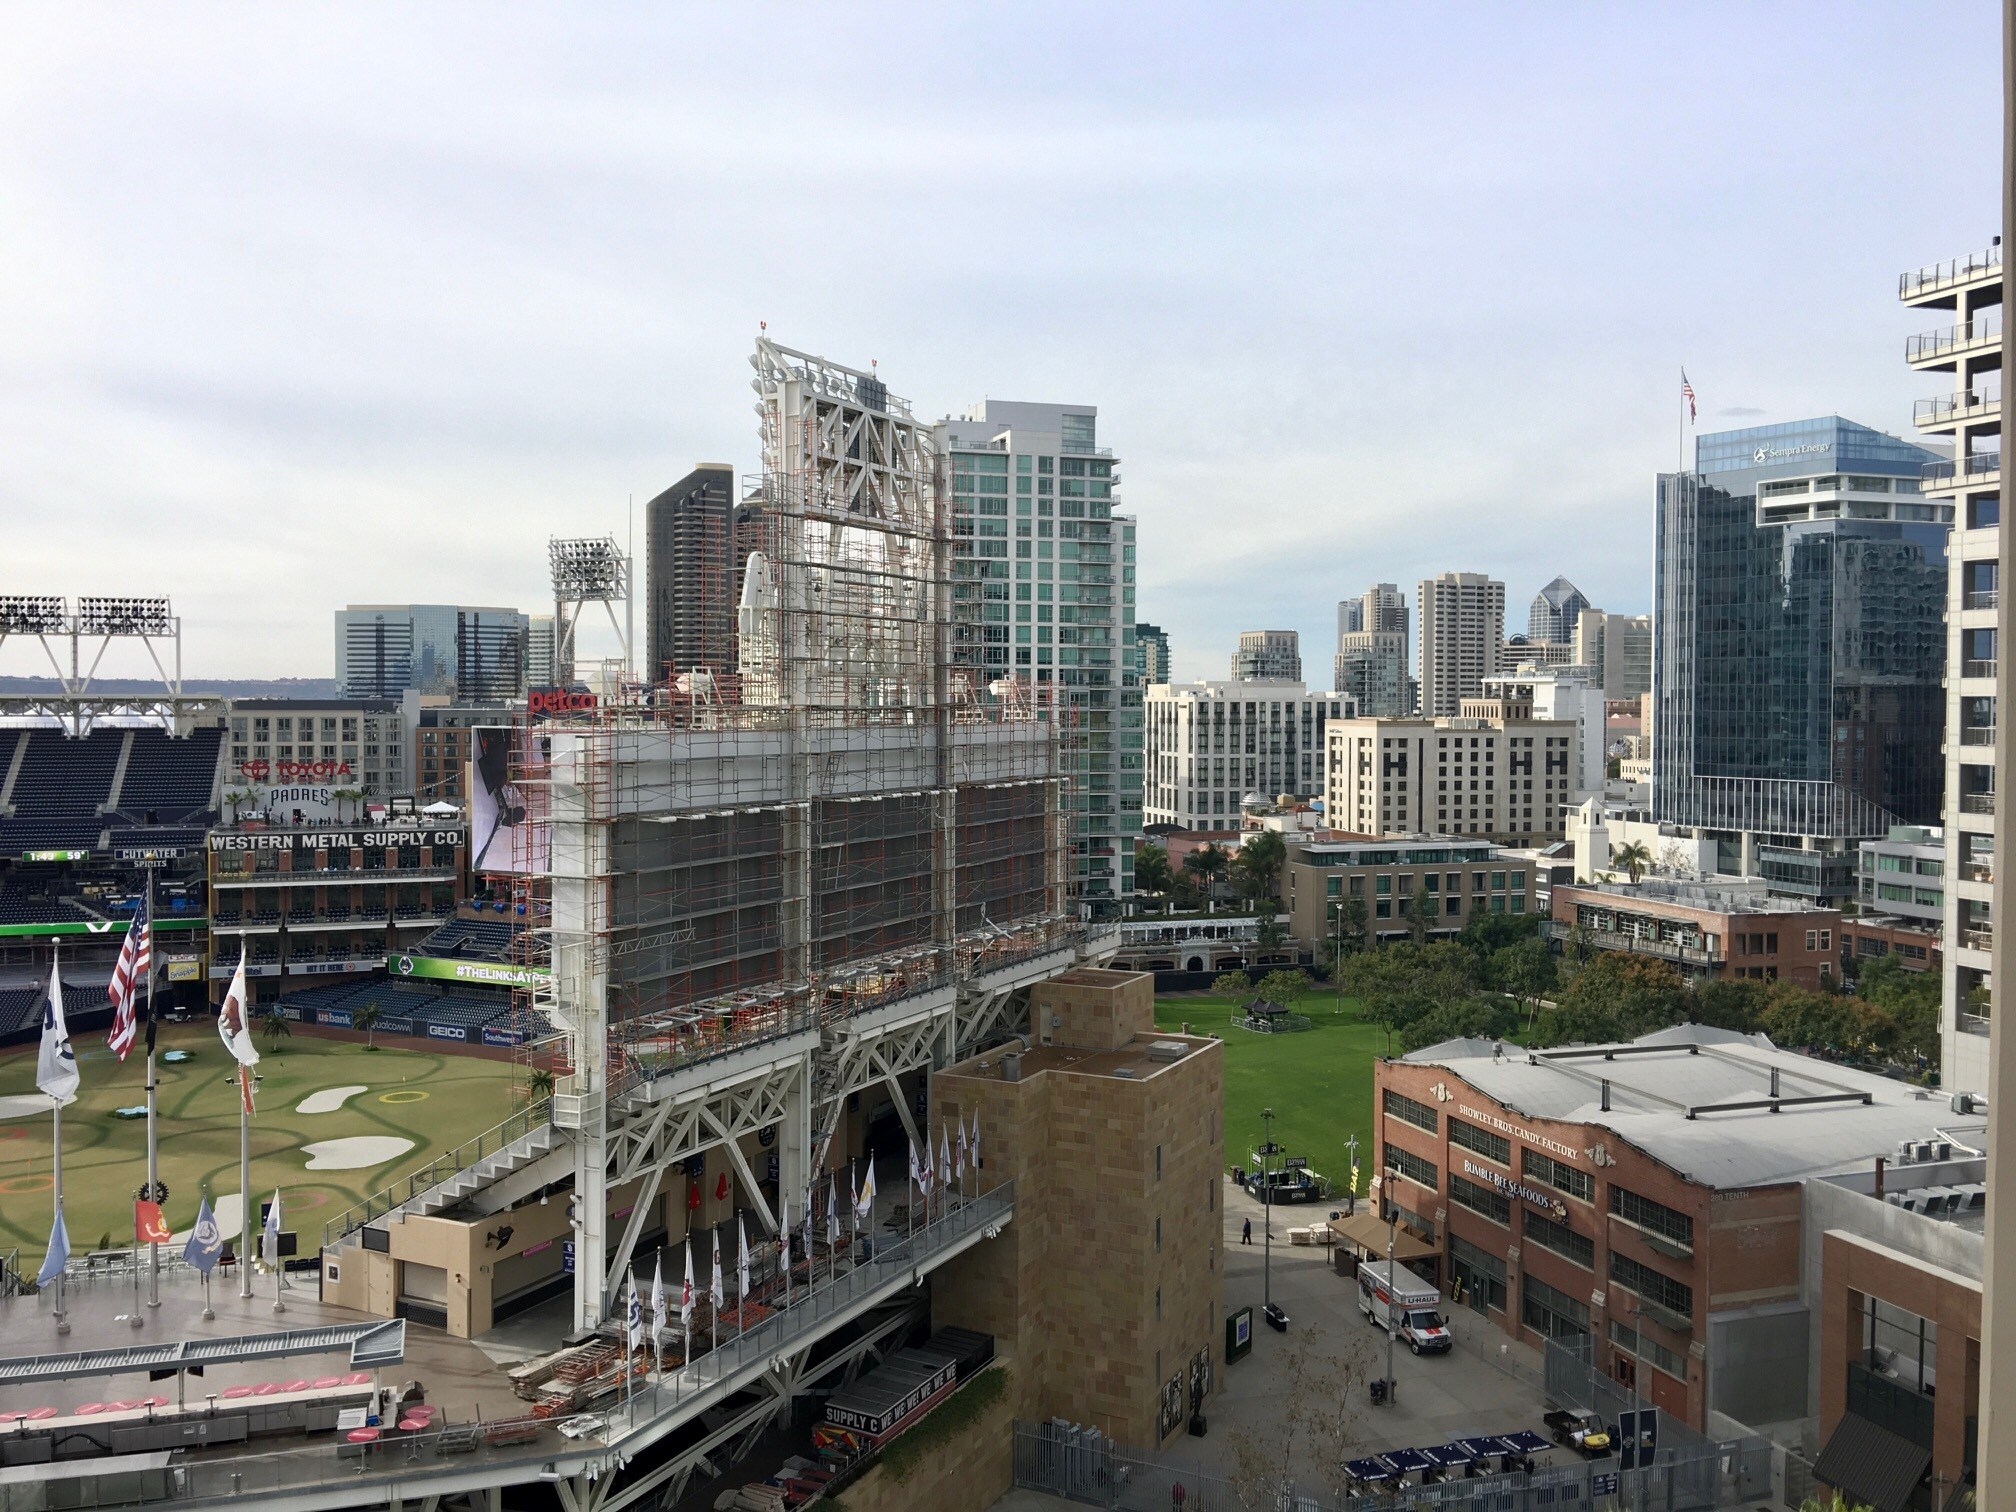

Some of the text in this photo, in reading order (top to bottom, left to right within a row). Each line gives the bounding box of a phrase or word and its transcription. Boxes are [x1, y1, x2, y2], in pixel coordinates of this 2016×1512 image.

[1769, 443, 1831, 457] Sempra Energy
[528, 688, 596, 712] petco
[276, 762, 351, 776] TOYOTA
[271, 788, 328, 806] PADRES
[210, 831, 462, 850] WESTERN METAL SUPPLY CO.
[134, 860, 167, 868] SPIRITS
[170, 966, 197, 979] Snapple
[429, 1026, 465, 1039] GEICO
[484, 1033, 517, 1043] Southwest
[1459, 1104, 1578, 1160] SHOWLEY BROS. CANDY FACTORY
[1464, 1159, 1549, 1208] BUMBLE BEE SEAFOODS
[1725, 1191, 1749, 1200] TENTH
[881, 1414, 893, 1430] WE
[894, 1403, 906, 1420] WE
[920, 1382, 932, 1400] WE
[934, 1372, 944, 1390] WE
[946, 1363, 956, 1379] WE
[826, 1407, 867, 1429] SUPPLY
